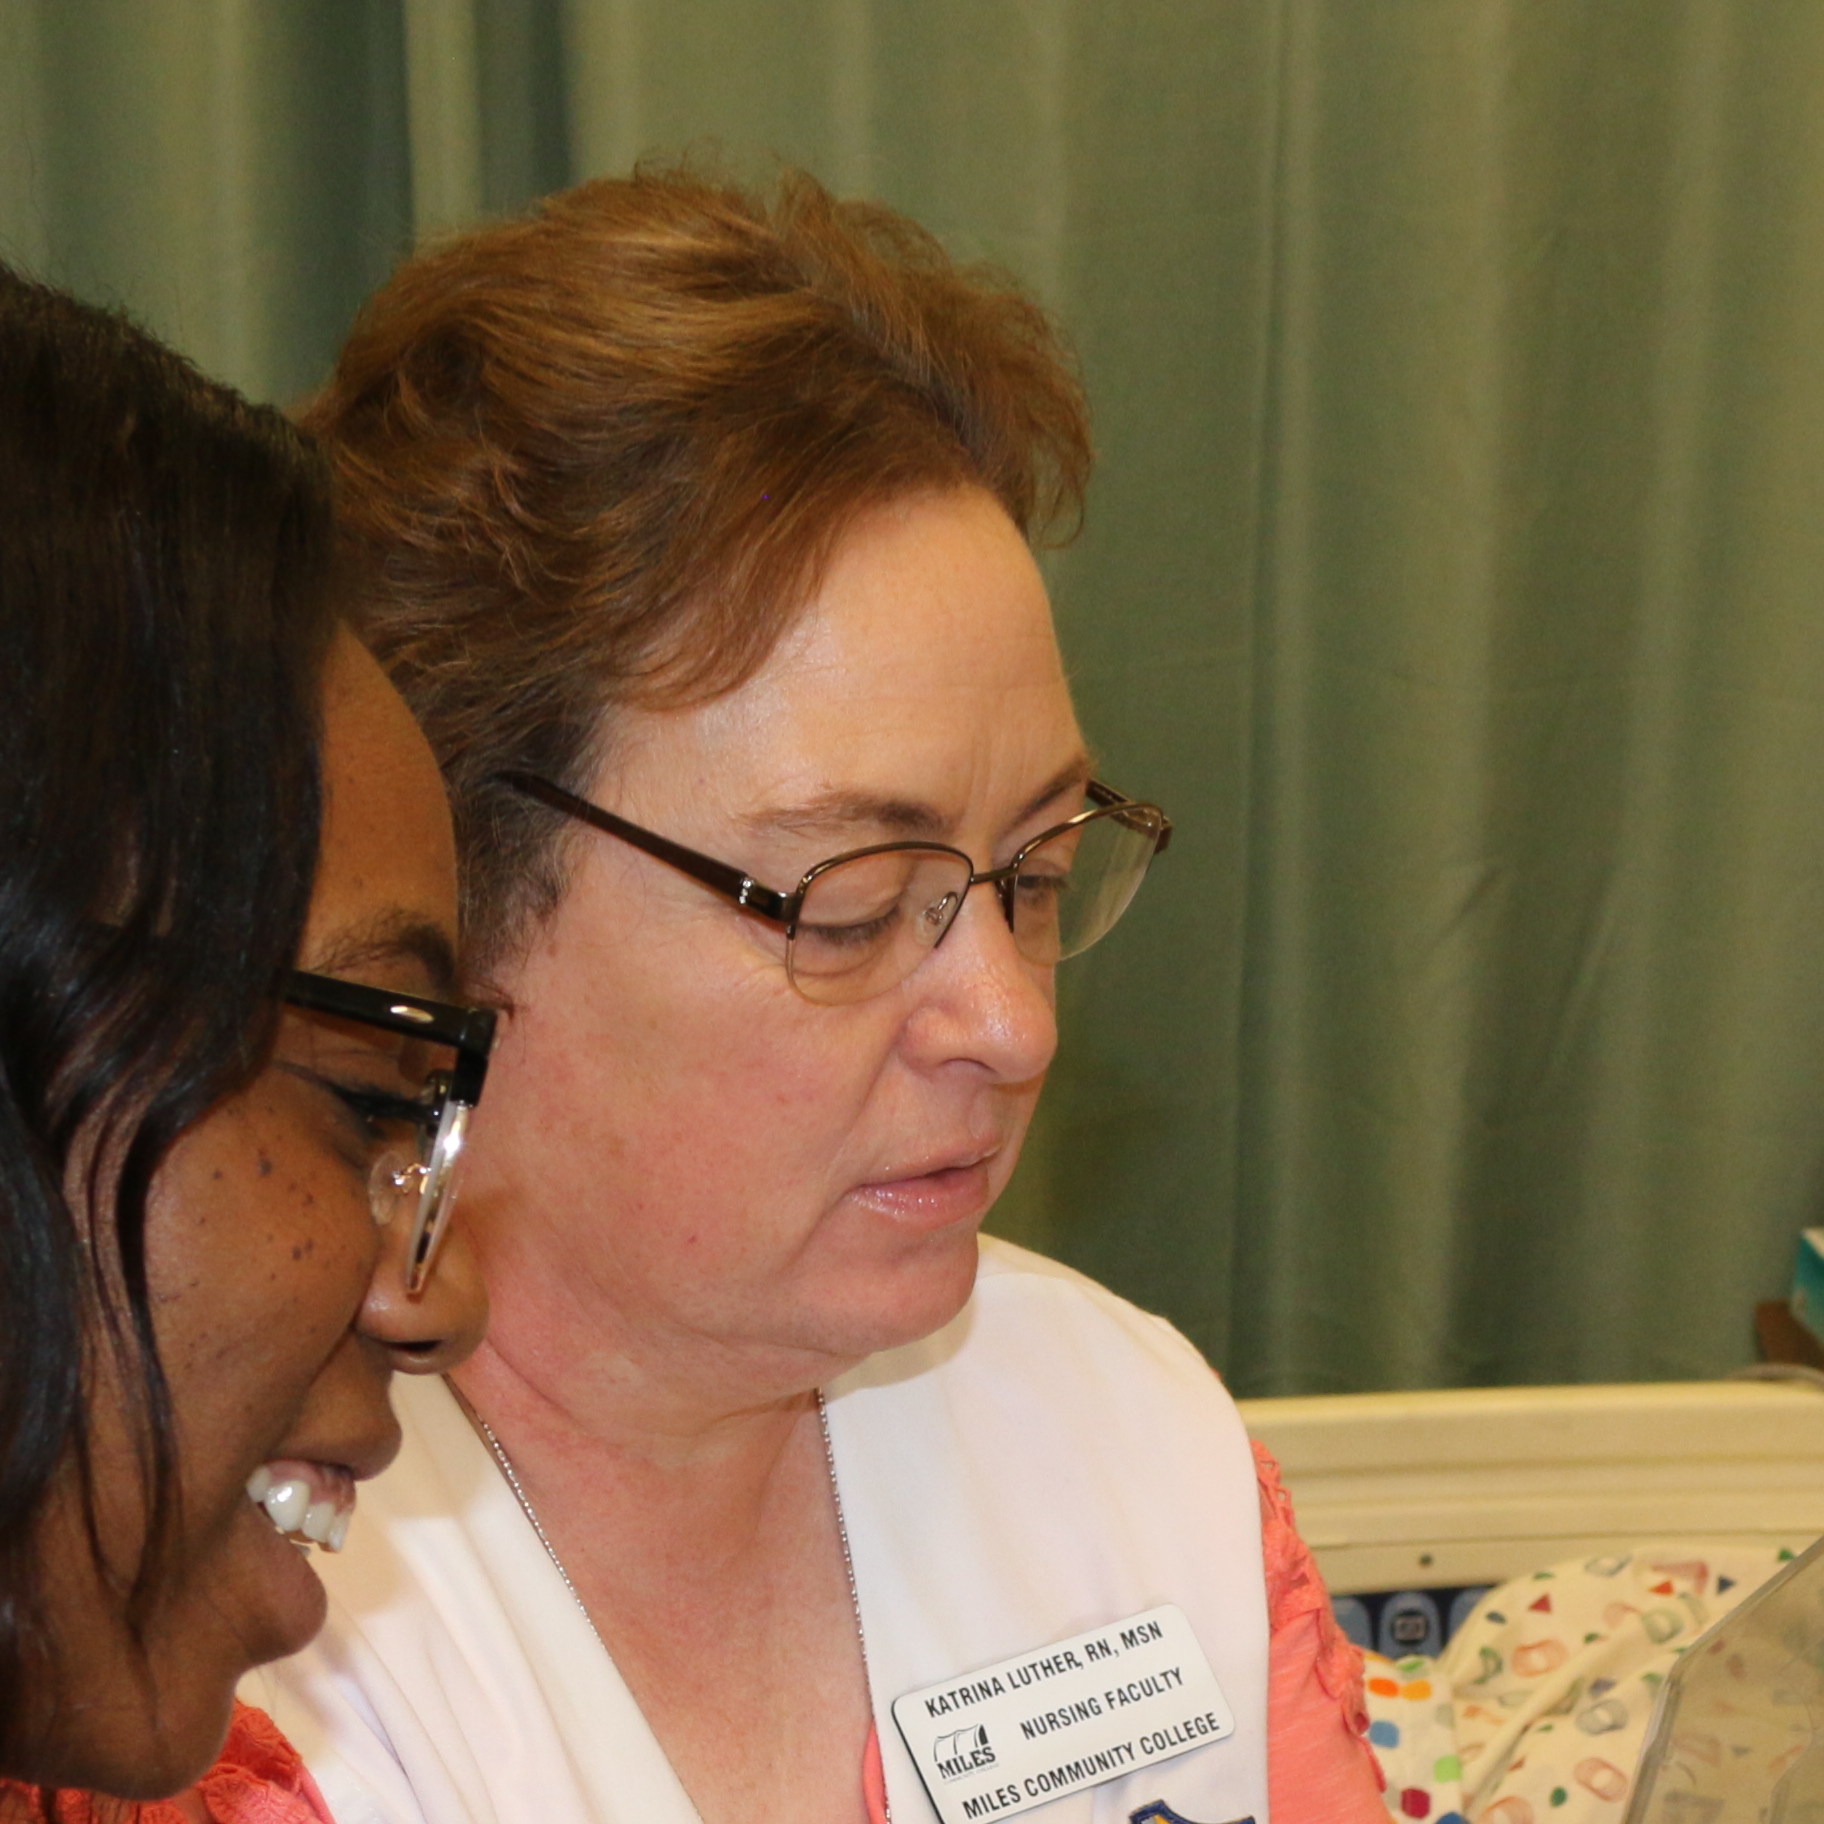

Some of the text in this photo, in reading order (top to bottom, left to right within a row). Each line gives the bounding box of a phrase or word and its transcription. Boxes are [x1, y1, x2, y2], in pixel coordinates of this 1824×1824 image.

[925, 1621, 1164, 1718] KATRINA LUTHER, RN, MSN
[1020, 1667, 1184, 1740] NURSING FACULTY
[937, 1746, 996, 1780] MILES
[962, 1712, 1220, 1820] MILES COMMUNITY COLLEGE
